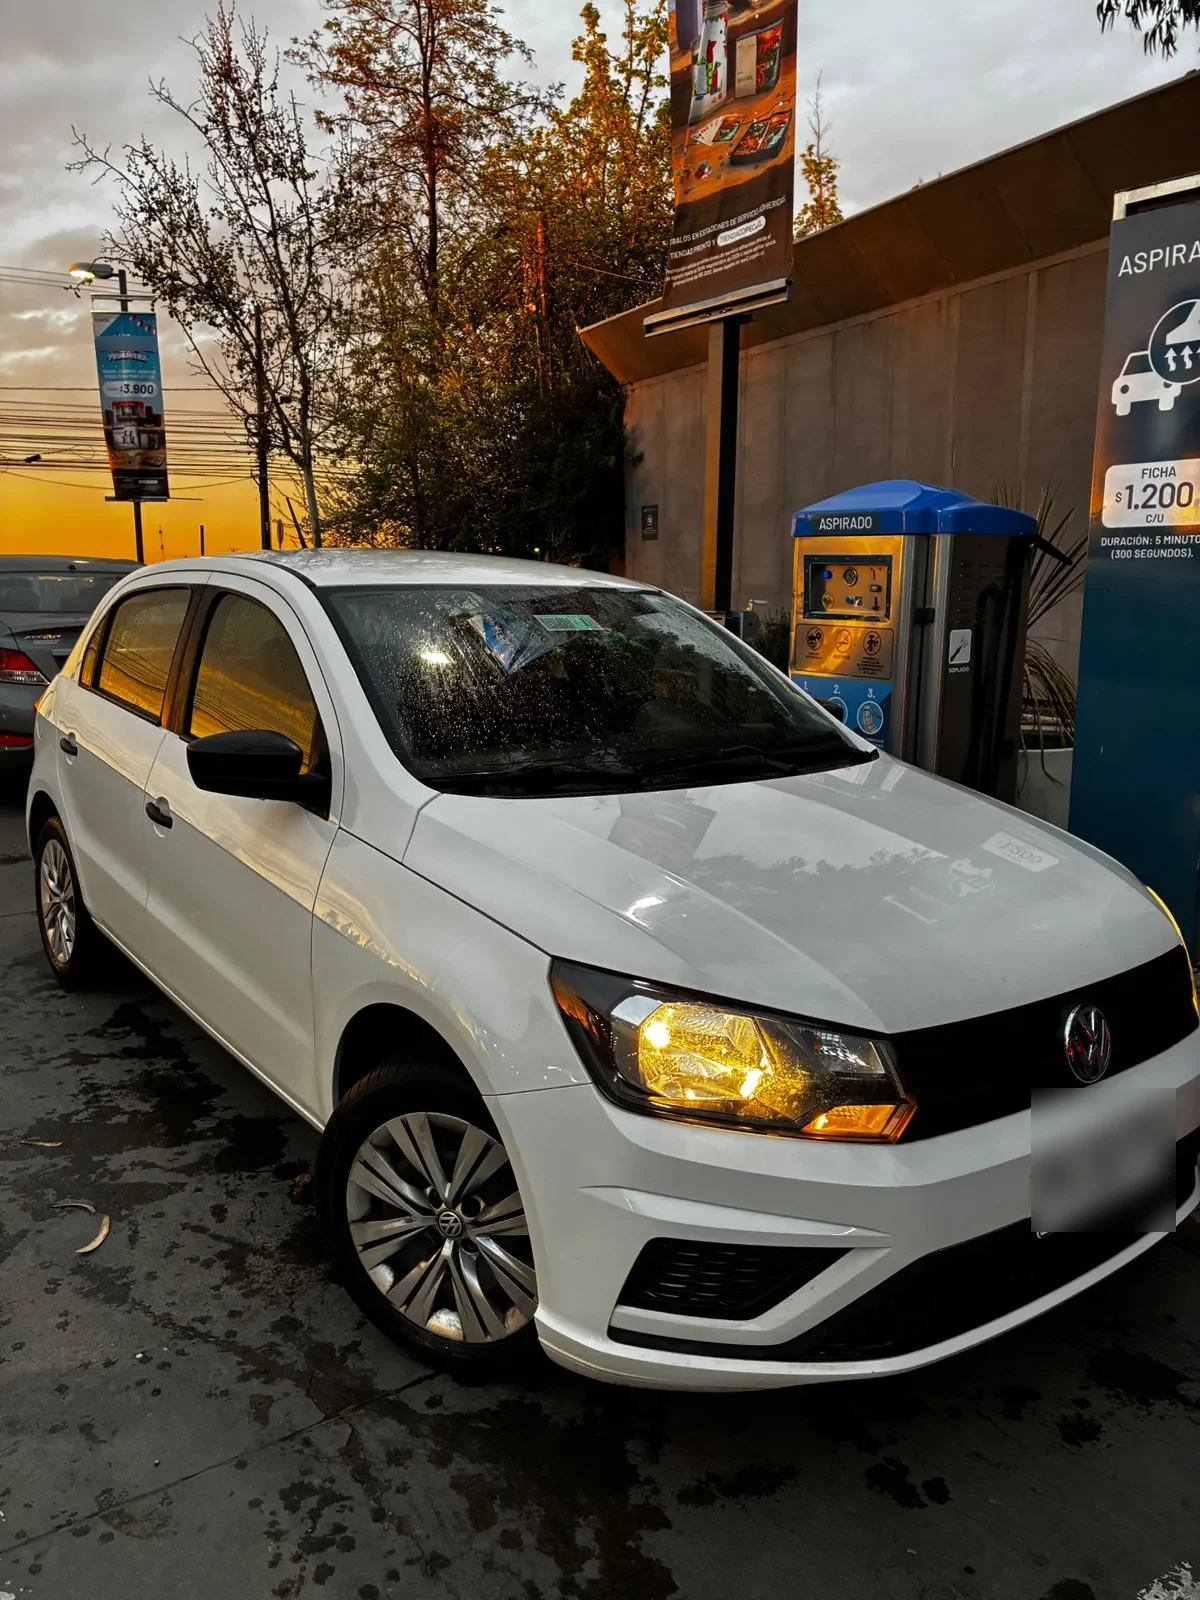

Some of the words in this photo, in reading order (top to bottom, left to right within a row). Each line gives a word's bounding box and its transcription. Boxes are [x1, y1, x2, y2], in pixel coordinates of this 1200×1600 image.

[670, 247, 694, 259] TIENDAS
[1141, 466, 1177, 479] FICHA
[819, 516, 873, 530] ASPIRADO
[1145, 514, 1164, 523] C/U
[1100, 534, 1153, 546] DURACIÓN:
[1155, 535, 1161, 544] 5
[1111, 549, 1132, 559] (300
[1134, 547, 1194, 559] SEGUNDOS).
[948, 665, 970, 674] SOPLADO
[833, 684, 841, 694] 2.
[867, 688, 875, 698] 3.
